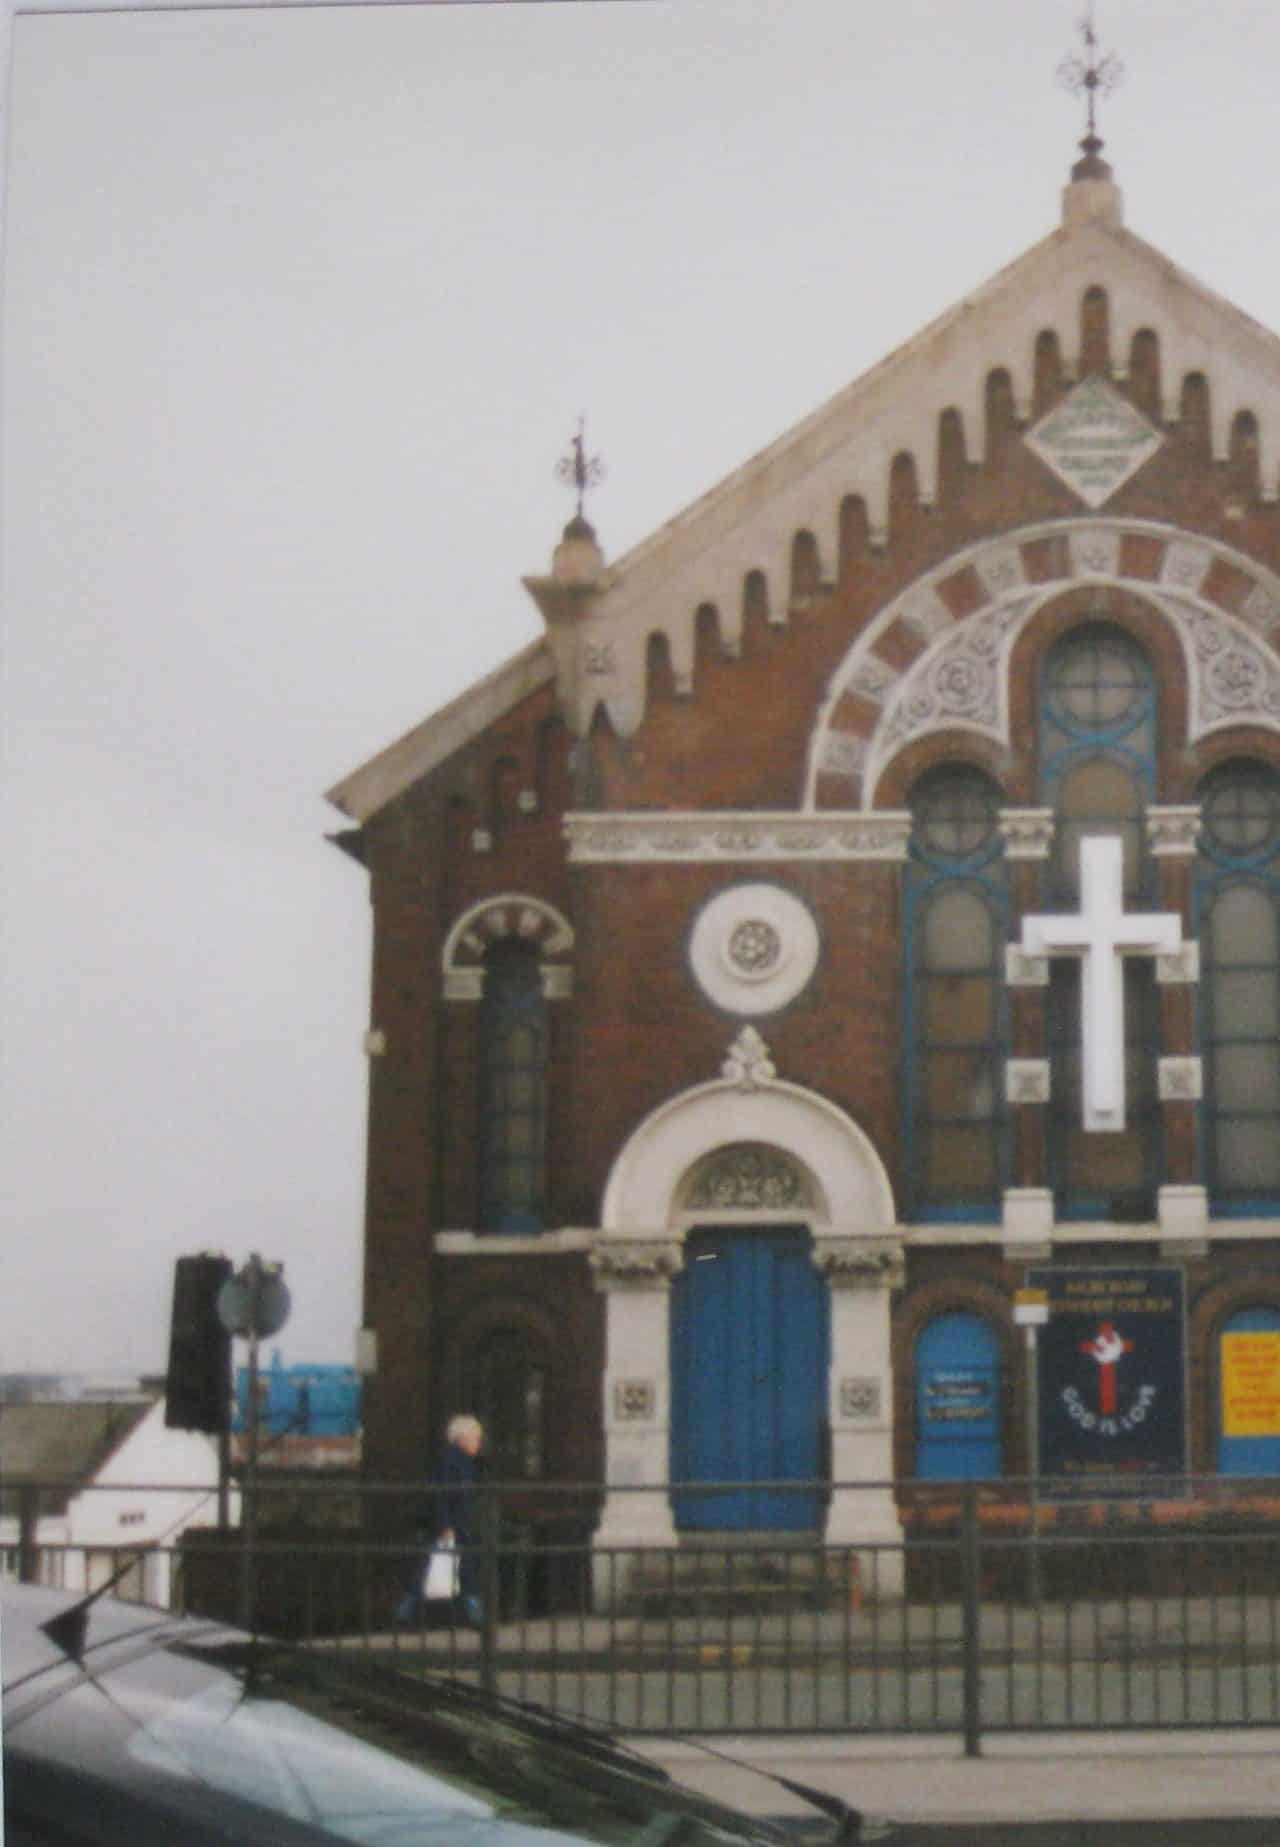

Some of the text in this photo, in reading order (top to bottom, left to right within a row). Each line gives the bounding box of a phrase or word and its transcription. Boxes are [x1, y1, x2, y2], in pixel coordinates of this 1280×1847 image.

[1062, 1384, 1156, 1436] GOD IS LOVE
